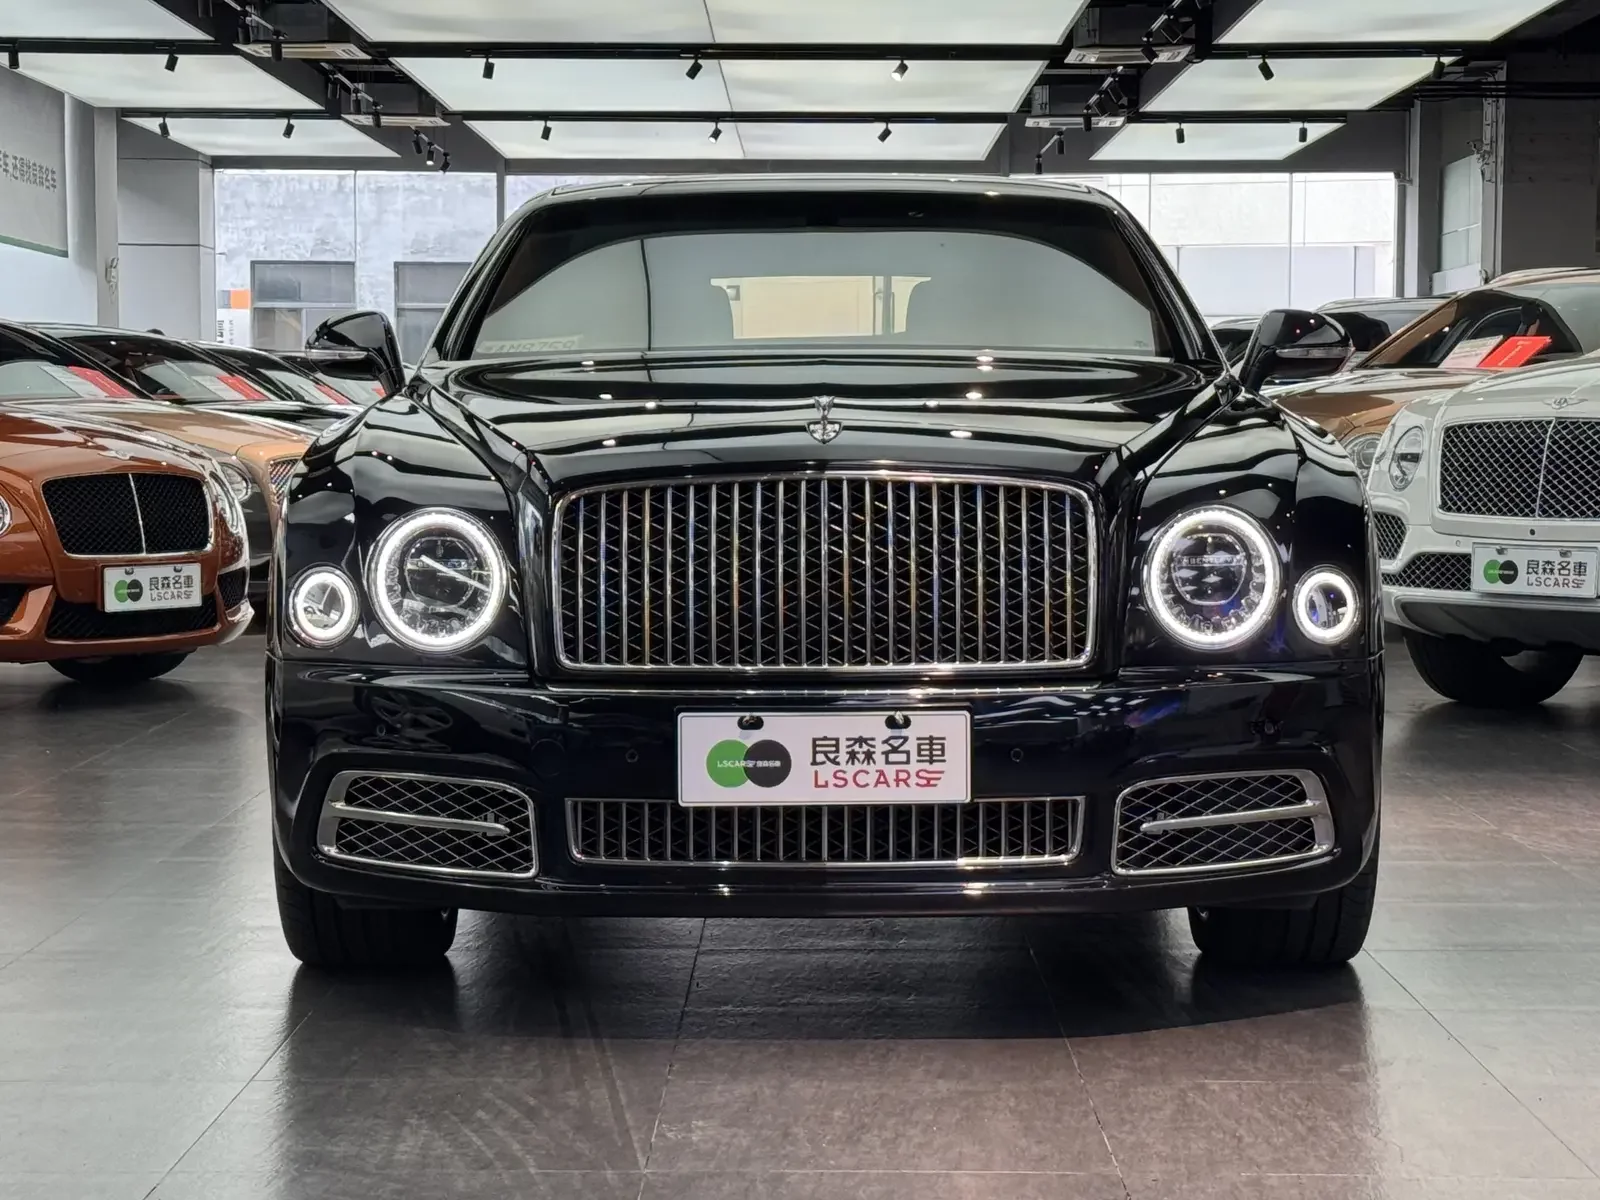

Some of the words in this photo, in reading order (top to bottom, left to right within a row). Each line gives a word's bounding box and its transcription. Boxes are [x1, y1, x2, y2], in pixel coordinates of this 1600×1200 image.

[1526, 559, 1587, 577] 良森名車
[149, 575, 194, 591] 良森名車
[1526, 576, 1586, 588] LSCARS
[150, 590, 193, 601] LSCARS
[810, 735, 947, 766] 良森名車
[813, 768, 945, 788] LSCARS
